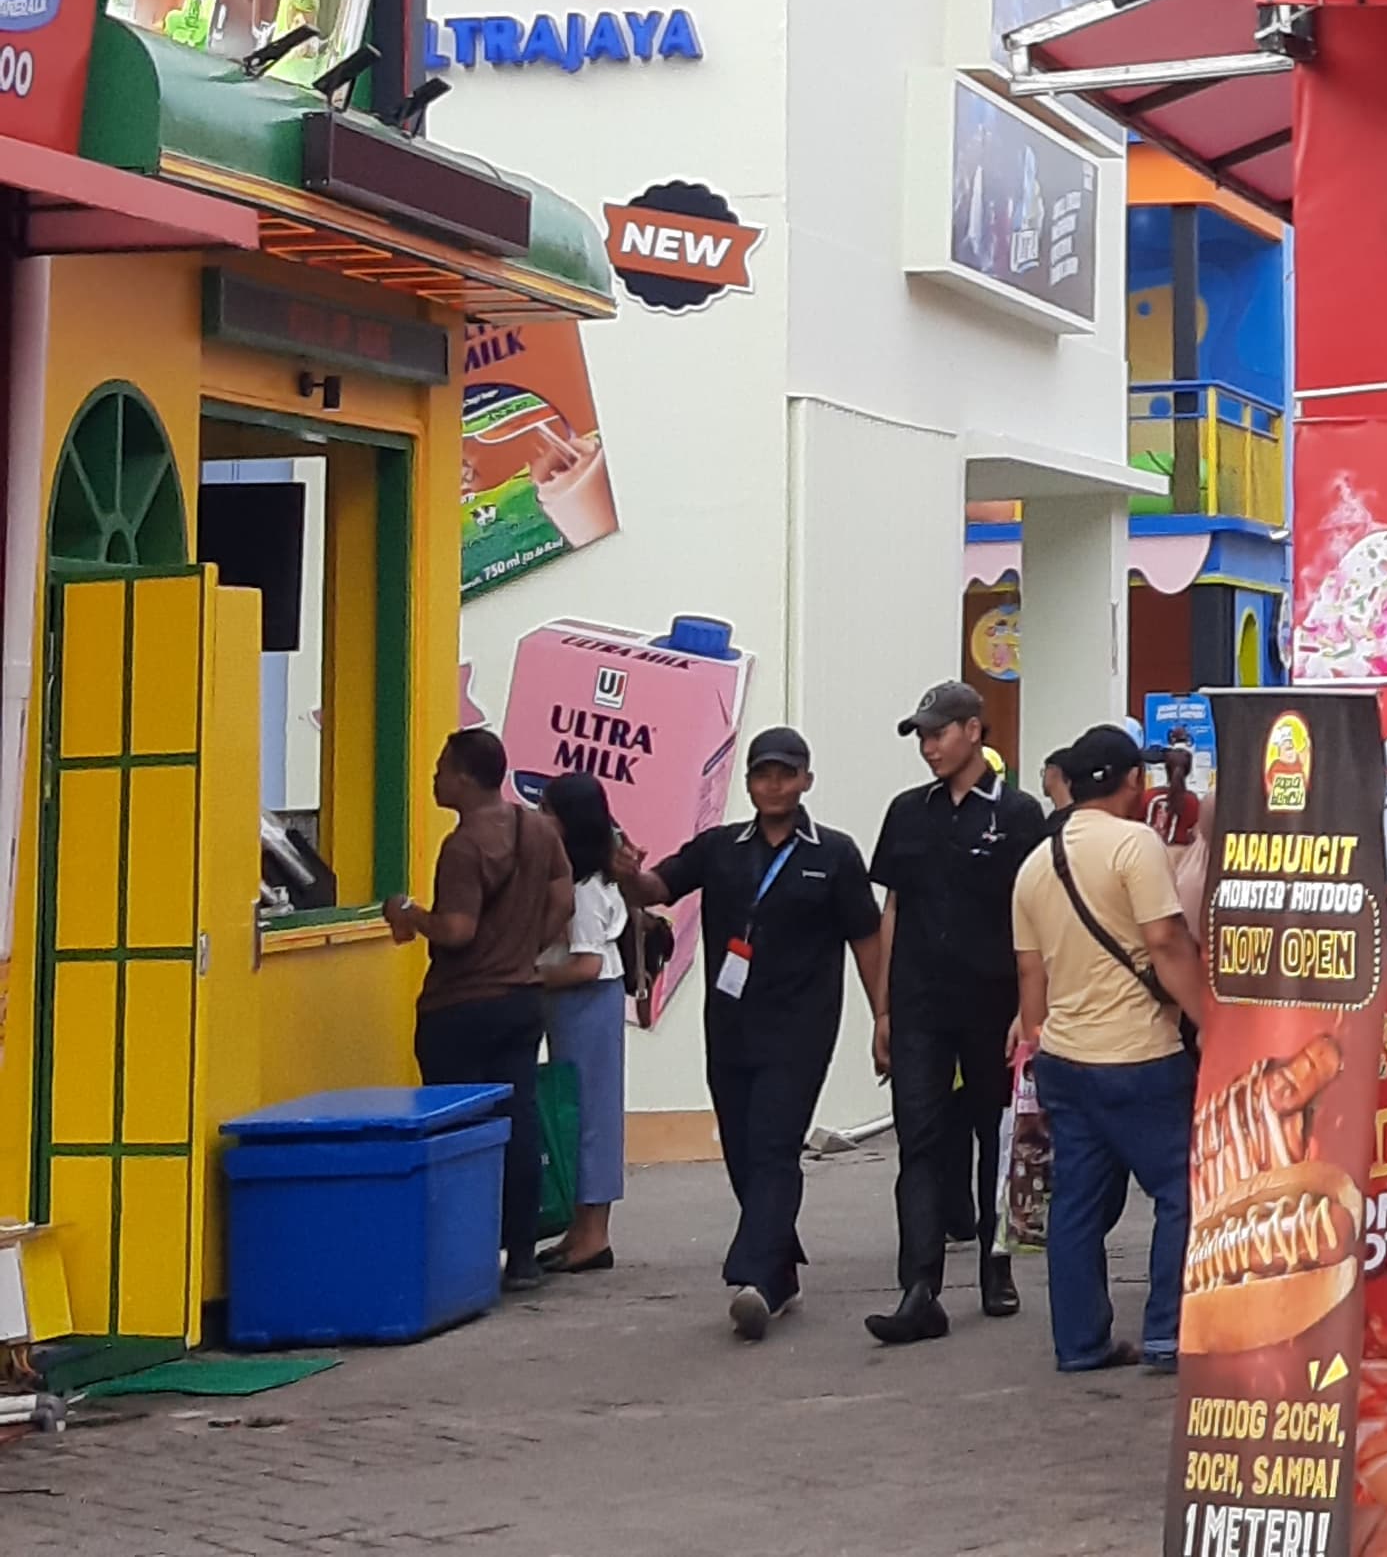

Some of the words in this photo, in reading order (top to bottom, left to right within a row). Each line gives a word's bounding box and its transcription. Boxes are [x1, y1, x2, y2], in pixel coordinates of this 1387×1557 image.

[424, 8, 704, 71] LTRAJAYA
[620, 220, 733, 271] NEW
[561, 635, 631, 658] ULTRA
[631, 650, 695, 670] MILK
[550, 704, 655, 756] ULTRA
[553, 739, 641, 786] MILK
[1222, 833, 1359, 875] PAPABUNCIT
[1219, 880, 1285, 910] MONSTER
[1289, 882, 1364, 914] HOTDOG
[1218, 925, 1273, 977] NOW
[1280, 927, 1356, 980] OPEN
[1187, 1396, 1268, 1439] HOTDOG
[1272, 1399, 1346, 1448] 20CM,
[1185, 1450, 1244, 1499] 30CM,
[1251, 1454, 1340, 1499] SAMPAI
[1184, 1503, 1198, 1556] 1
[1201, 1504, 1331, 1557] METER!!
